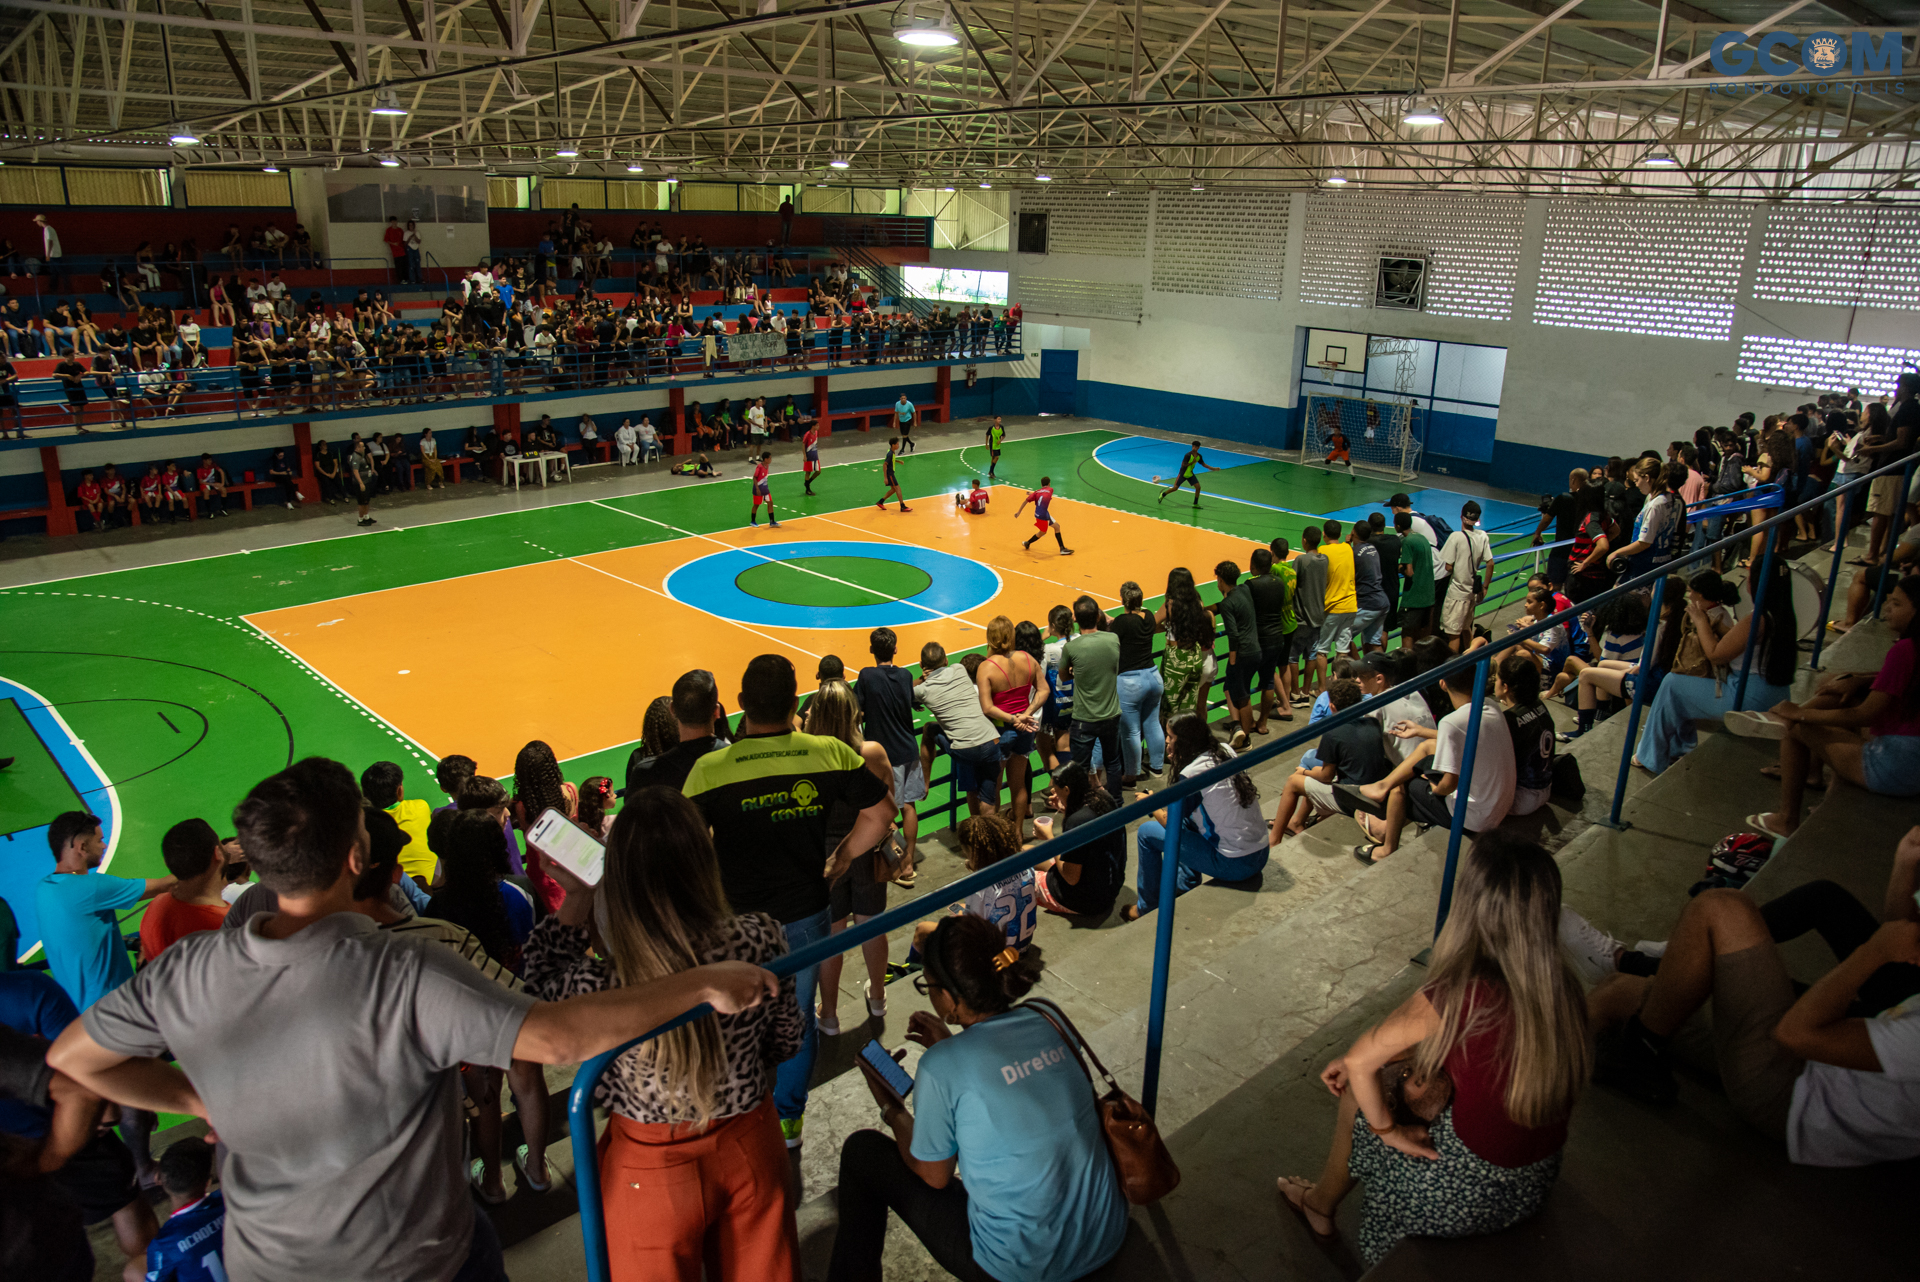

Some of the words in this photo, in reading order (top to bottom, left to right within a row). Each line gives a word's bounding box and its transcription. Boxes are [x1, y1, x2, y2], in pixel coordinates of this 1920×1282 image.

[741, 791, 789, 812] AUDIO
[771, 804, 824, 823] CENTER
[1000, 1045, 1066, 1086] Diretor
